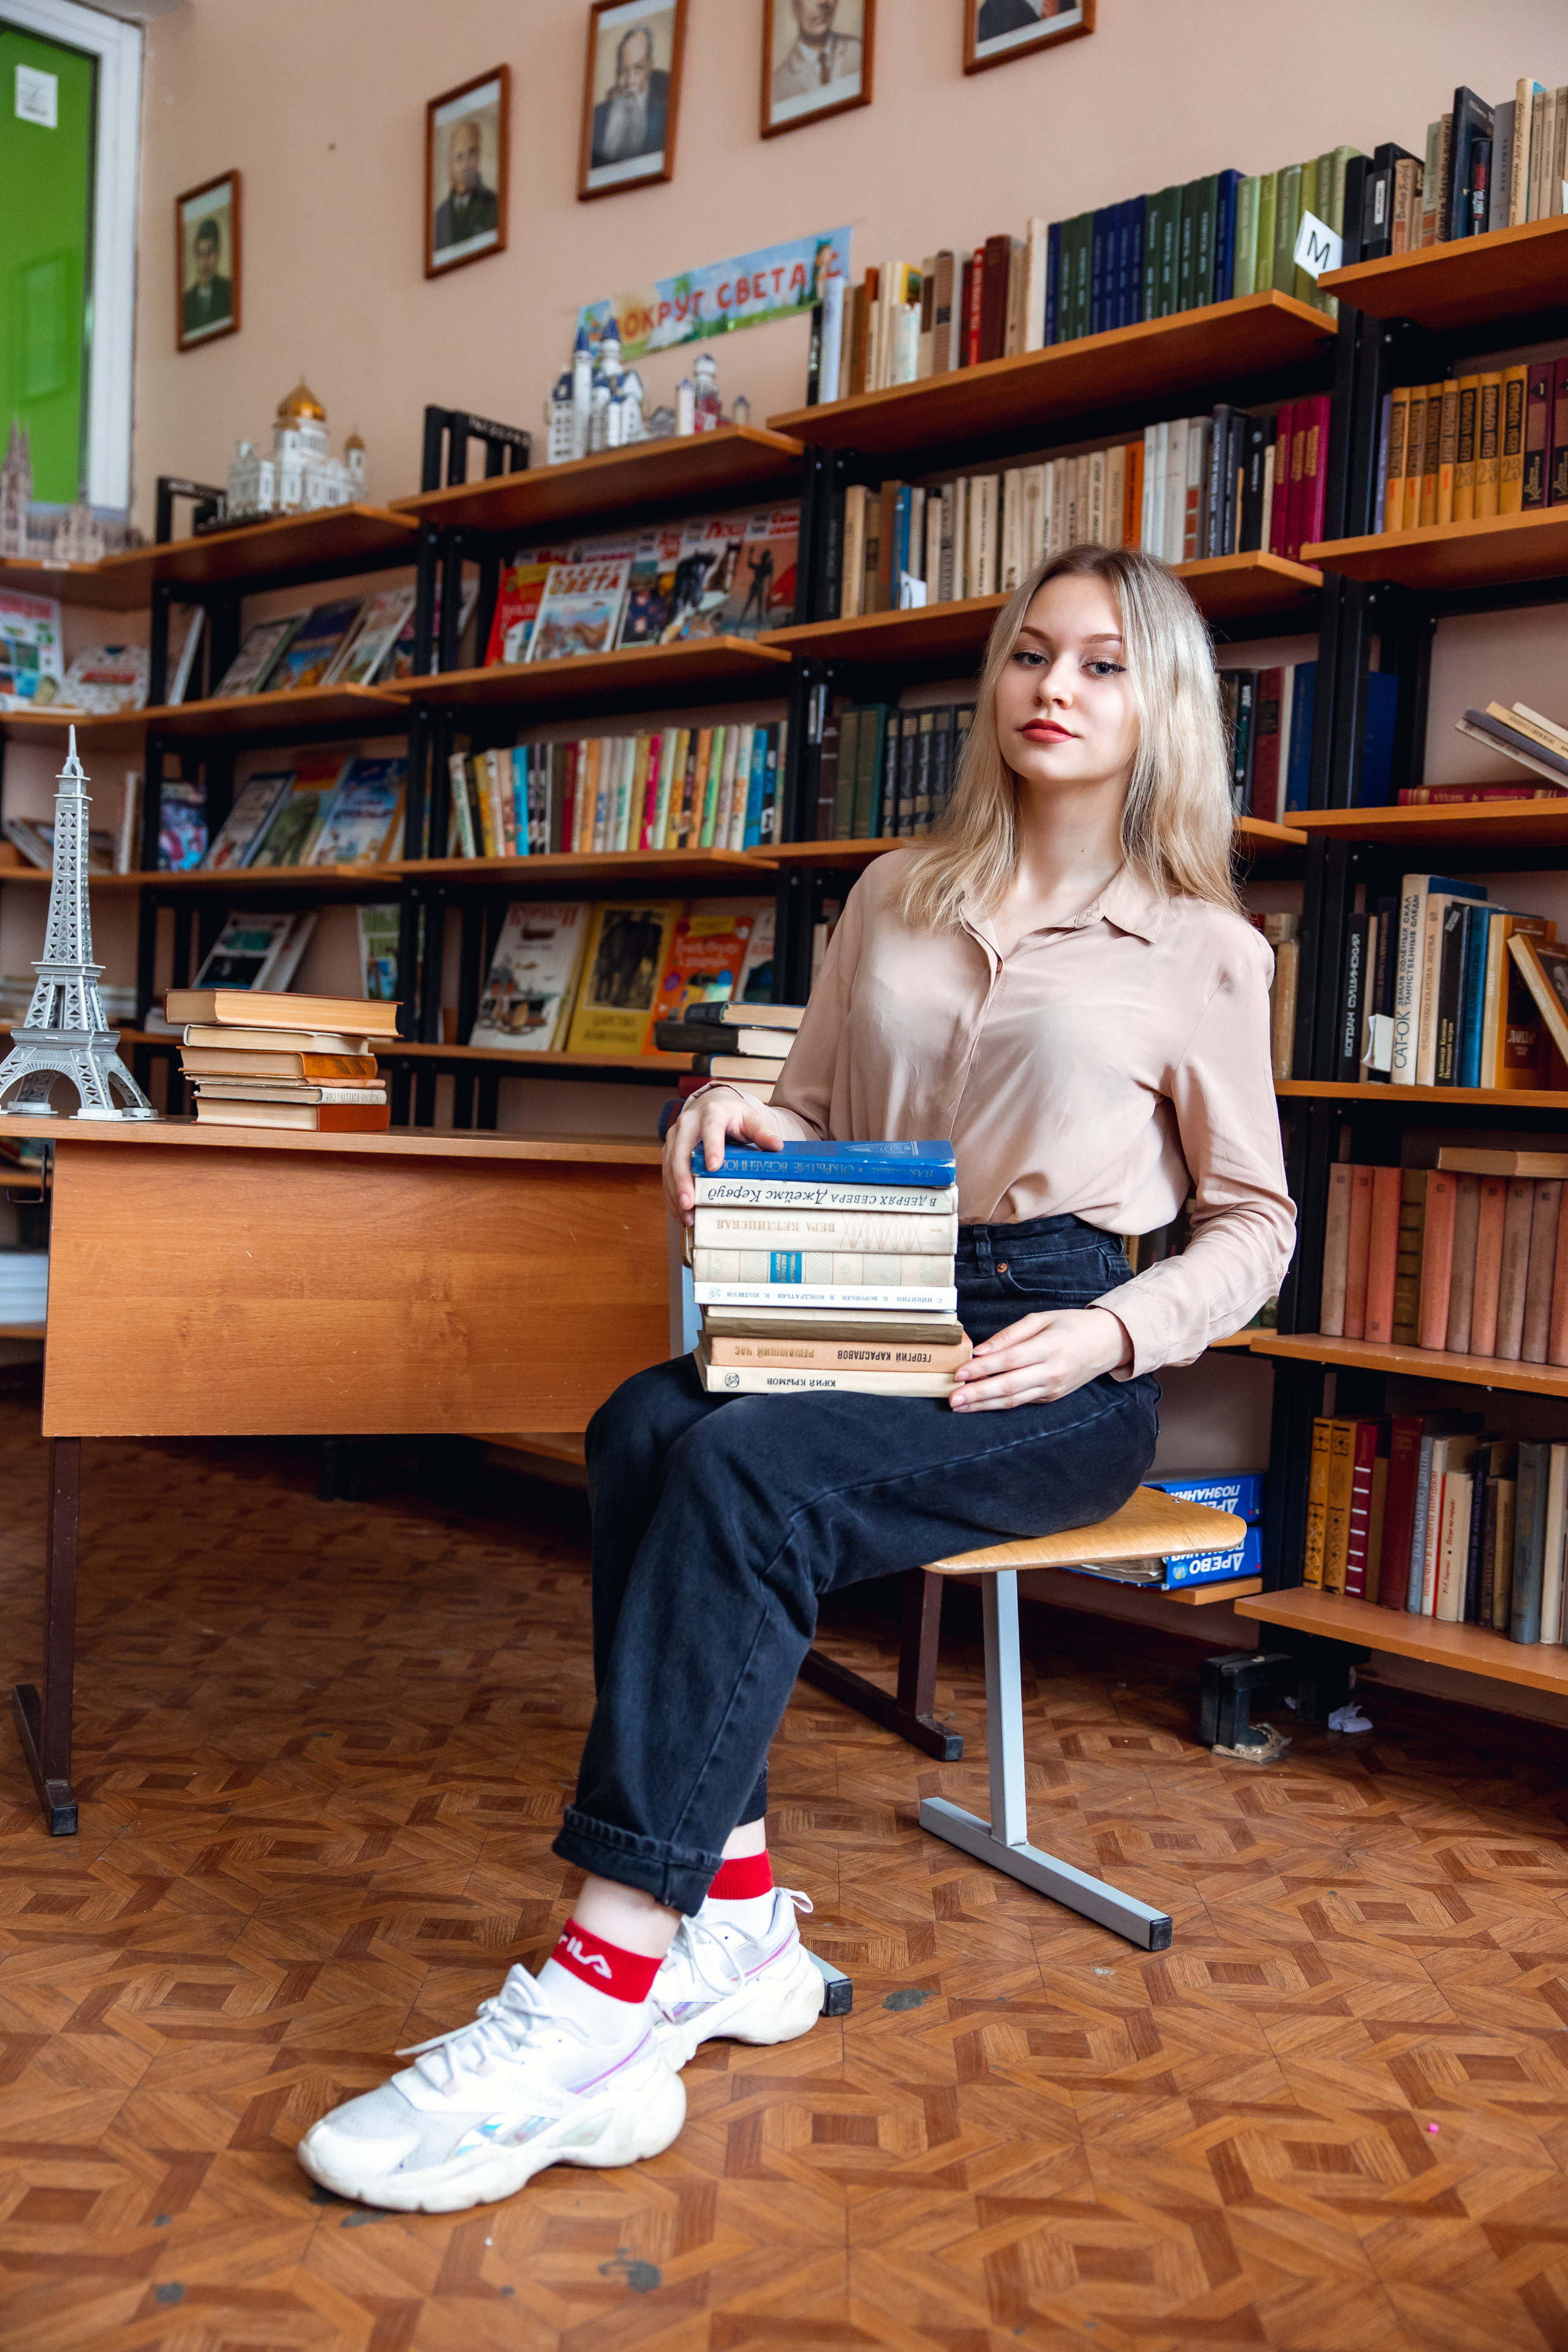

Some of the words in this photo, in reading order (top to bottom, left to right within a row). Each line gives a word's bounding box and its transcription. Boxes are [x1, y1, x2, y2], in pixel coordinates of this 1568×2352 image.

[1307, 230, 1330, 270] М
[615, 290, 705, 336] ОКРУГ
[716, 263, 807, 310] СВЕТА
[1393, 1011, 1411, 1068] САТ-ОК
[794, 1161, 854, 1175] ОТКРЫТИЕ
[707, 1185, 763, 1203] Кервуд
[766, 1188, 828, 1205] Джеймс
[831, 1194, 876, 1205] СЕВЕРА
[879, 1195, 927, 1207] ДЕБРЯХ
[929, 1197, 938, 1207] В
[716, 1219, 799, 1231] КЕТЛИНСКАЯ
[805, 1221, 835, 1232] ВЕРА
[734, 1345, 753, 1356] ЧАС
[757, 1346, 815, 1359] РЕШАЮЩИЙ
[837, 1349, 891, 1361] КАРАСЛАВОВ
[895, 1352, 932, 1363] ГЕОРГИЙ
[767, 1378, 806, 1387] КРЫМОВ
[809, 1378, 836, 1387] ЮРИЙ
[1198, 1498, 1239, 1514] ДРЕ
[1189, 1552, 1245, 1574] ДРЕВО
